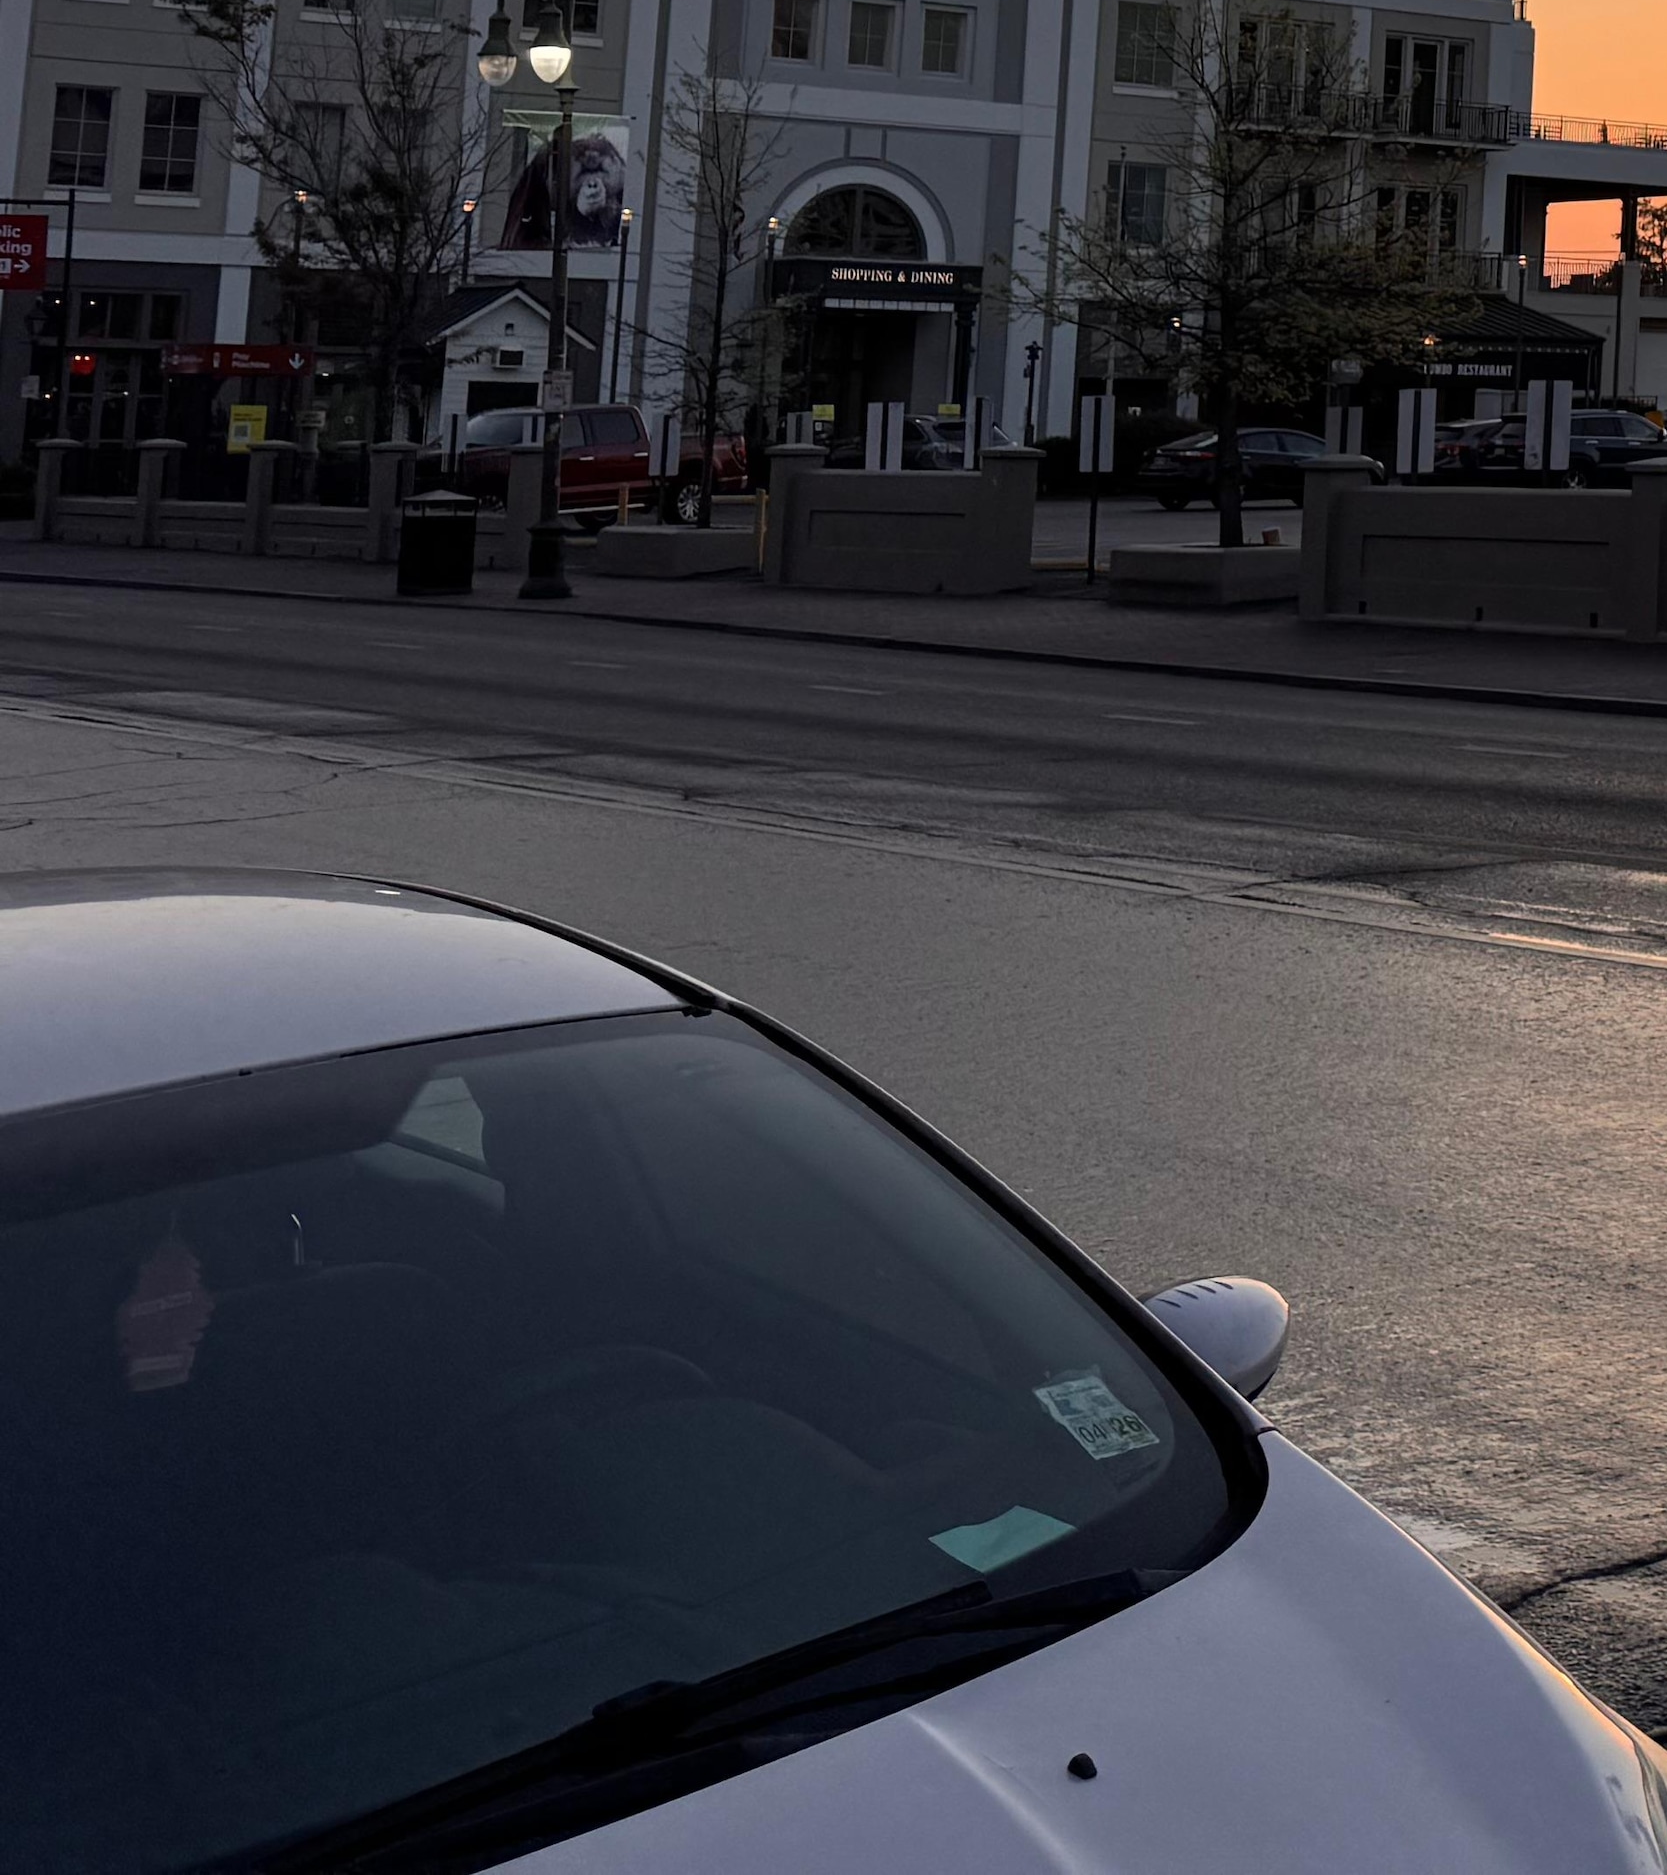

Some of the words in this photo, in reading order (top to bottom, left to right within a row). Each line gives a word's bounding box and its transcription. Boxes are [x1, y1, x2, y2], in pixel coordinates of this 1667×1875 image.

[831, 267, 893, 283] SHOPPING
[897, 270, 907, 283] &
[910, 270, 954, 285] DINING
[1457, 363, 1512, 377] RESTAURANT
[1079, 1423, 1107, 1443] 04
[1110, 1415, 1141, 1437] 26
